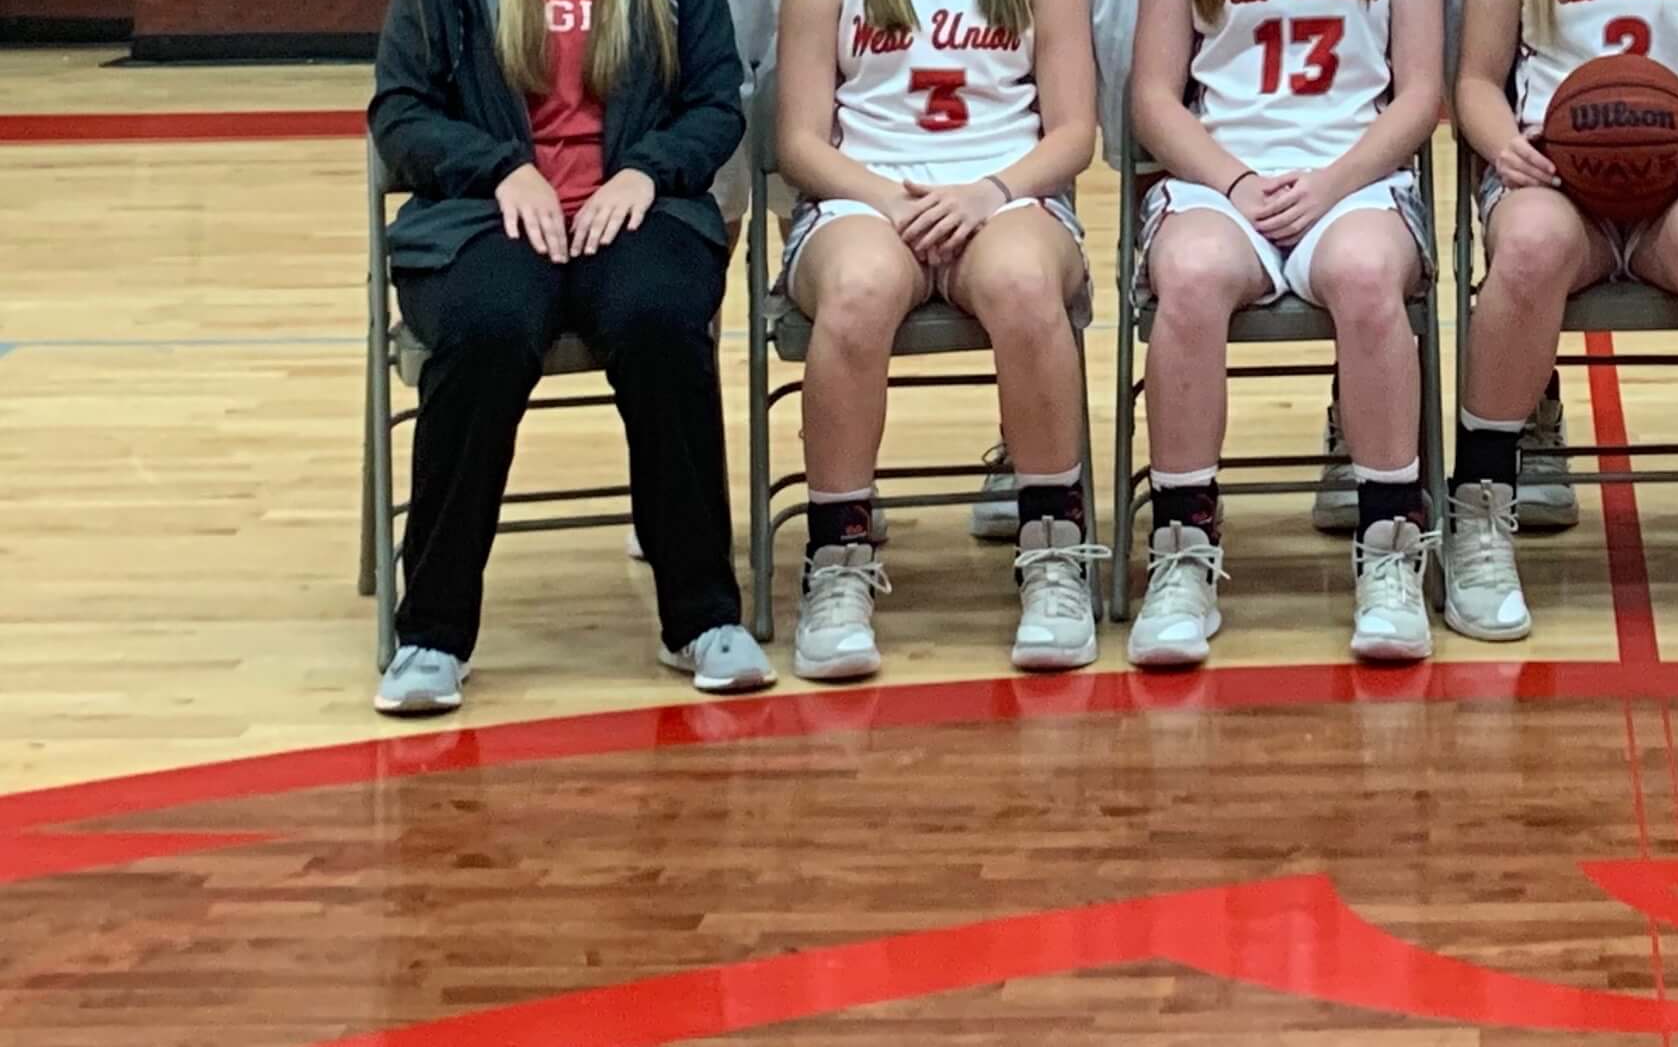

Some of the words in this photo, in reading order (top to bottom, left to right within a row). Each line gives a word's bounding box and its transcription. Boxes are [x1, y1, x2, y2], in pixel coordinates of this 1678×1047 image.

[853, 15, 914, 57] West
[931, 8, 1021, 51] Union
[1253, 17, 1343, 96] 13
[908, 67, 969, 133] 3
[1570, 102, 1676, 132] Wilson
